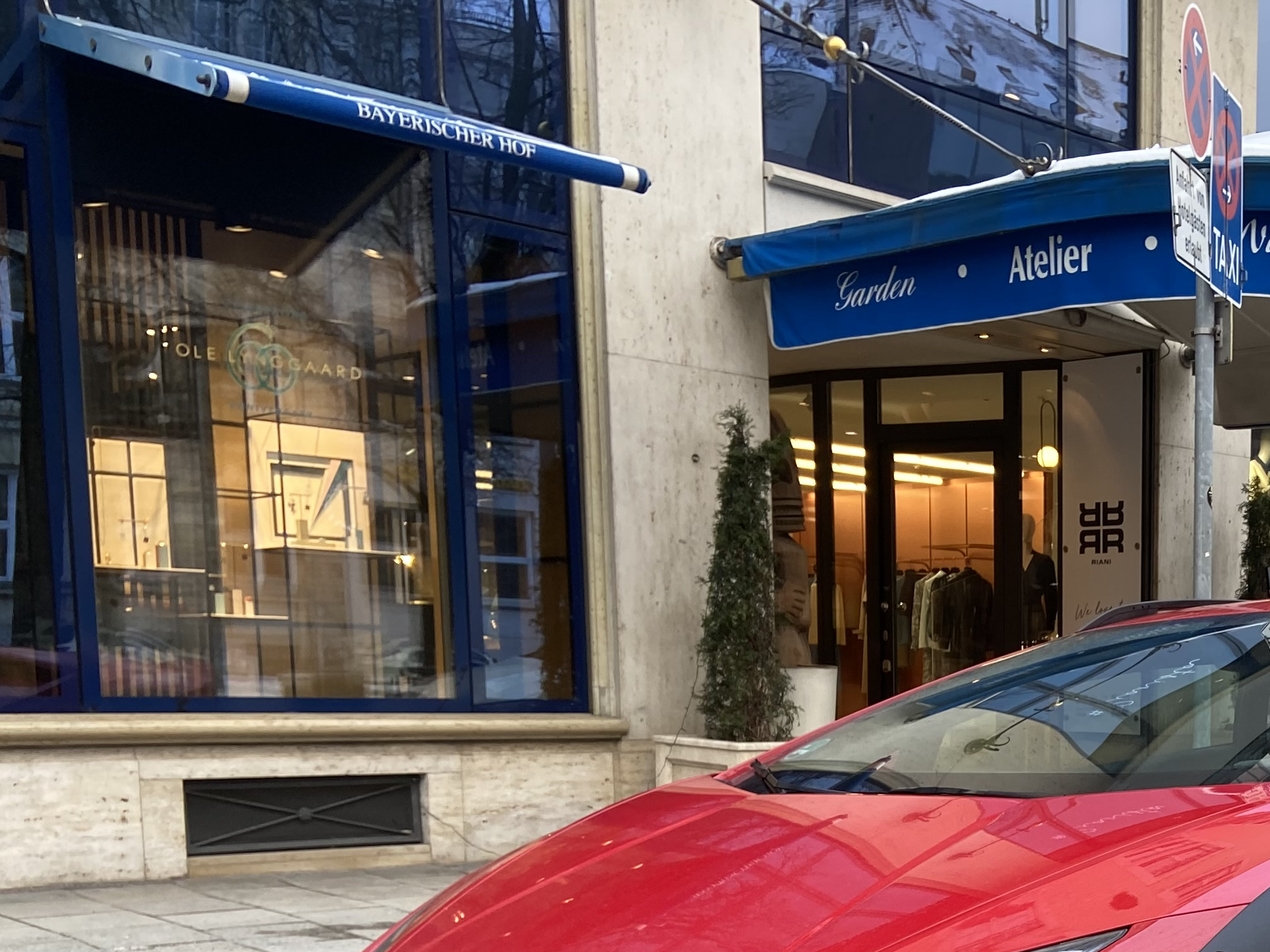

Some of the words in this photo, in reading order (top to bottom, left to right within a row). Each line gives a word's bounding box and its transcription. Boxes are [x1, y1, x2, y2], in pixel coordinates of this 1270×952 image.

[357, 102, 495, 149] BAYERISCHER
[499, 136, 537, 158] HOF
[1196, 188, 1205, 209] von
[1185, 235, 1202, 263] erlaubt
[1213, 226, 1239, 286] TAXI
[834, 265, 917, 311] Garden
[1008, 235, 1092, 284] Atelier
[175, 342, 216, 361] OLE
[1075, 602, 1092, 620] We
